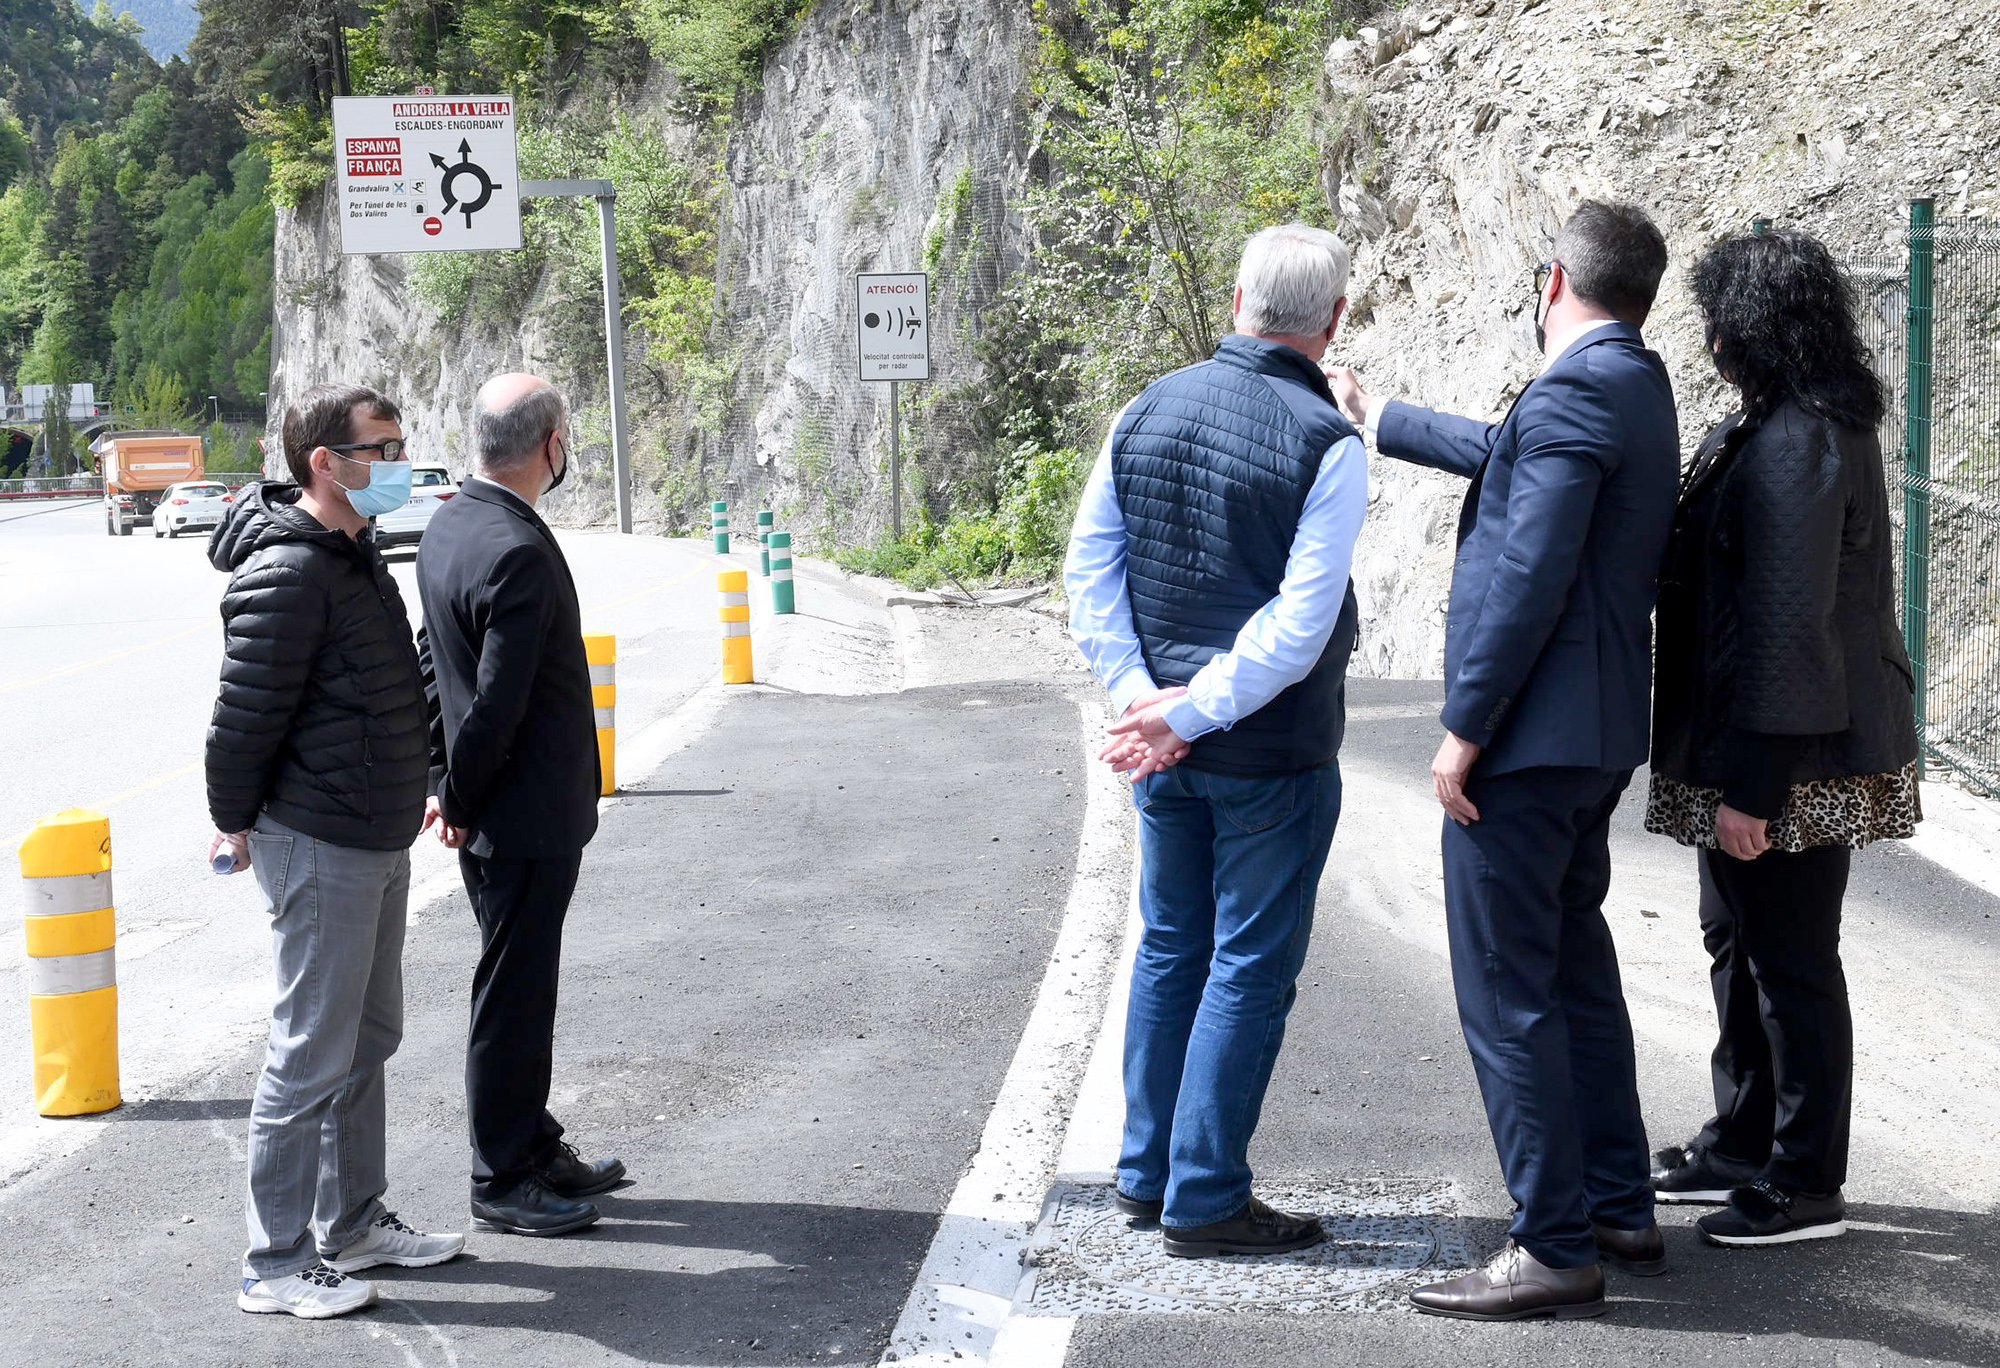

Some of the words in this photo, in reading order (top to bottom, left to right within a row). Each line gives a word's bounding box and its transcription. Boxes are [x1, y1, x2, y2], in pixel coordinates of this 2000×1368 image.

[394, 103, 450, 116] ANDORRA
[454, 103, 467, 115] LA
[472, 102, 509, 115] VELLA
[395, 120, 504, 131] ESCALDES-ENGORDANY
[348, 140, 399, 153] ESPANYA
[348, 160, 401, 176] FRANÇA
[348, 184, 390, 193] Grandvalira
[386, 201, 394, 209] de
[396, 200, 407, 208] les
[866, 283, 918, 294] ATENCIÓ!
